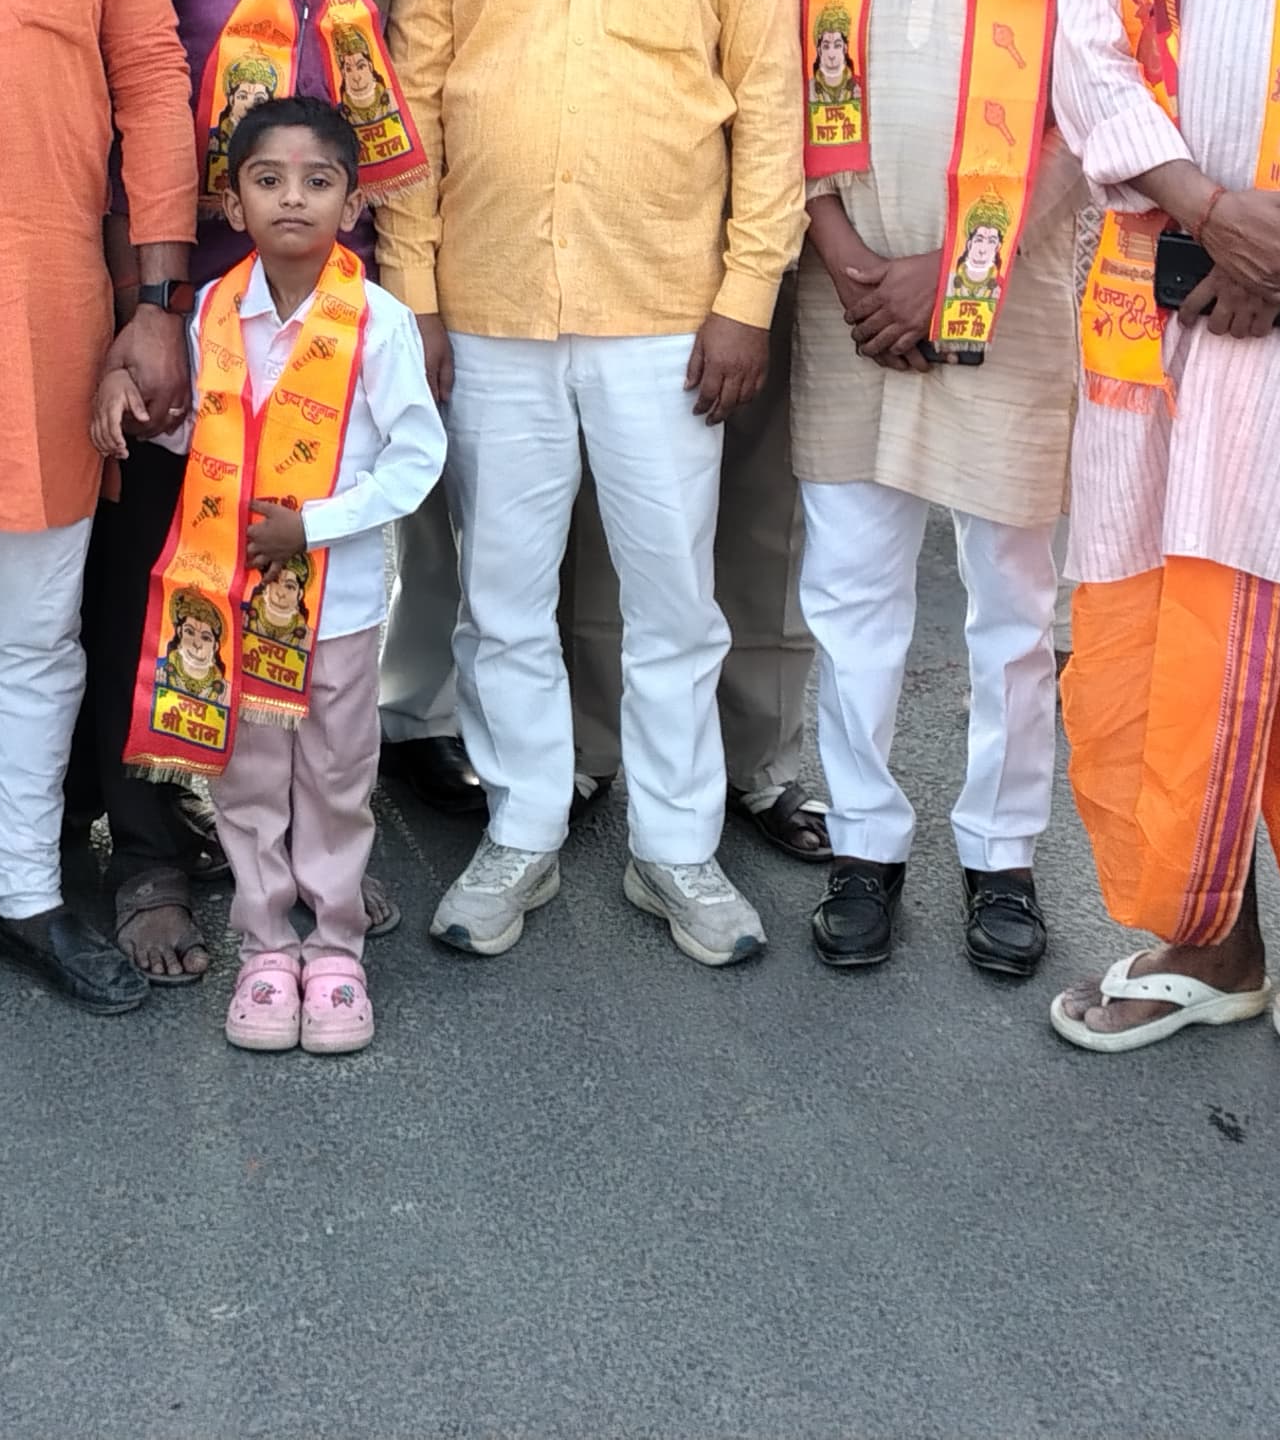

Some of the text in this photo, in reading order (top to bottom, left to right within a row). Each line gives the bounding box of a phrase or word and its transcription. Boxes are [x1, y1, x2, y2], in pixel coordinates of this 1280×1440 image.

[358, 122, 388, 143] जय
[373, 134, 405, 158] राम
[257, 637, 288, 662] जय
[266, 663, 300, 688] राम
[176, 692, 209, 717] जय
[160, 707, 221, 747] श्री राम
